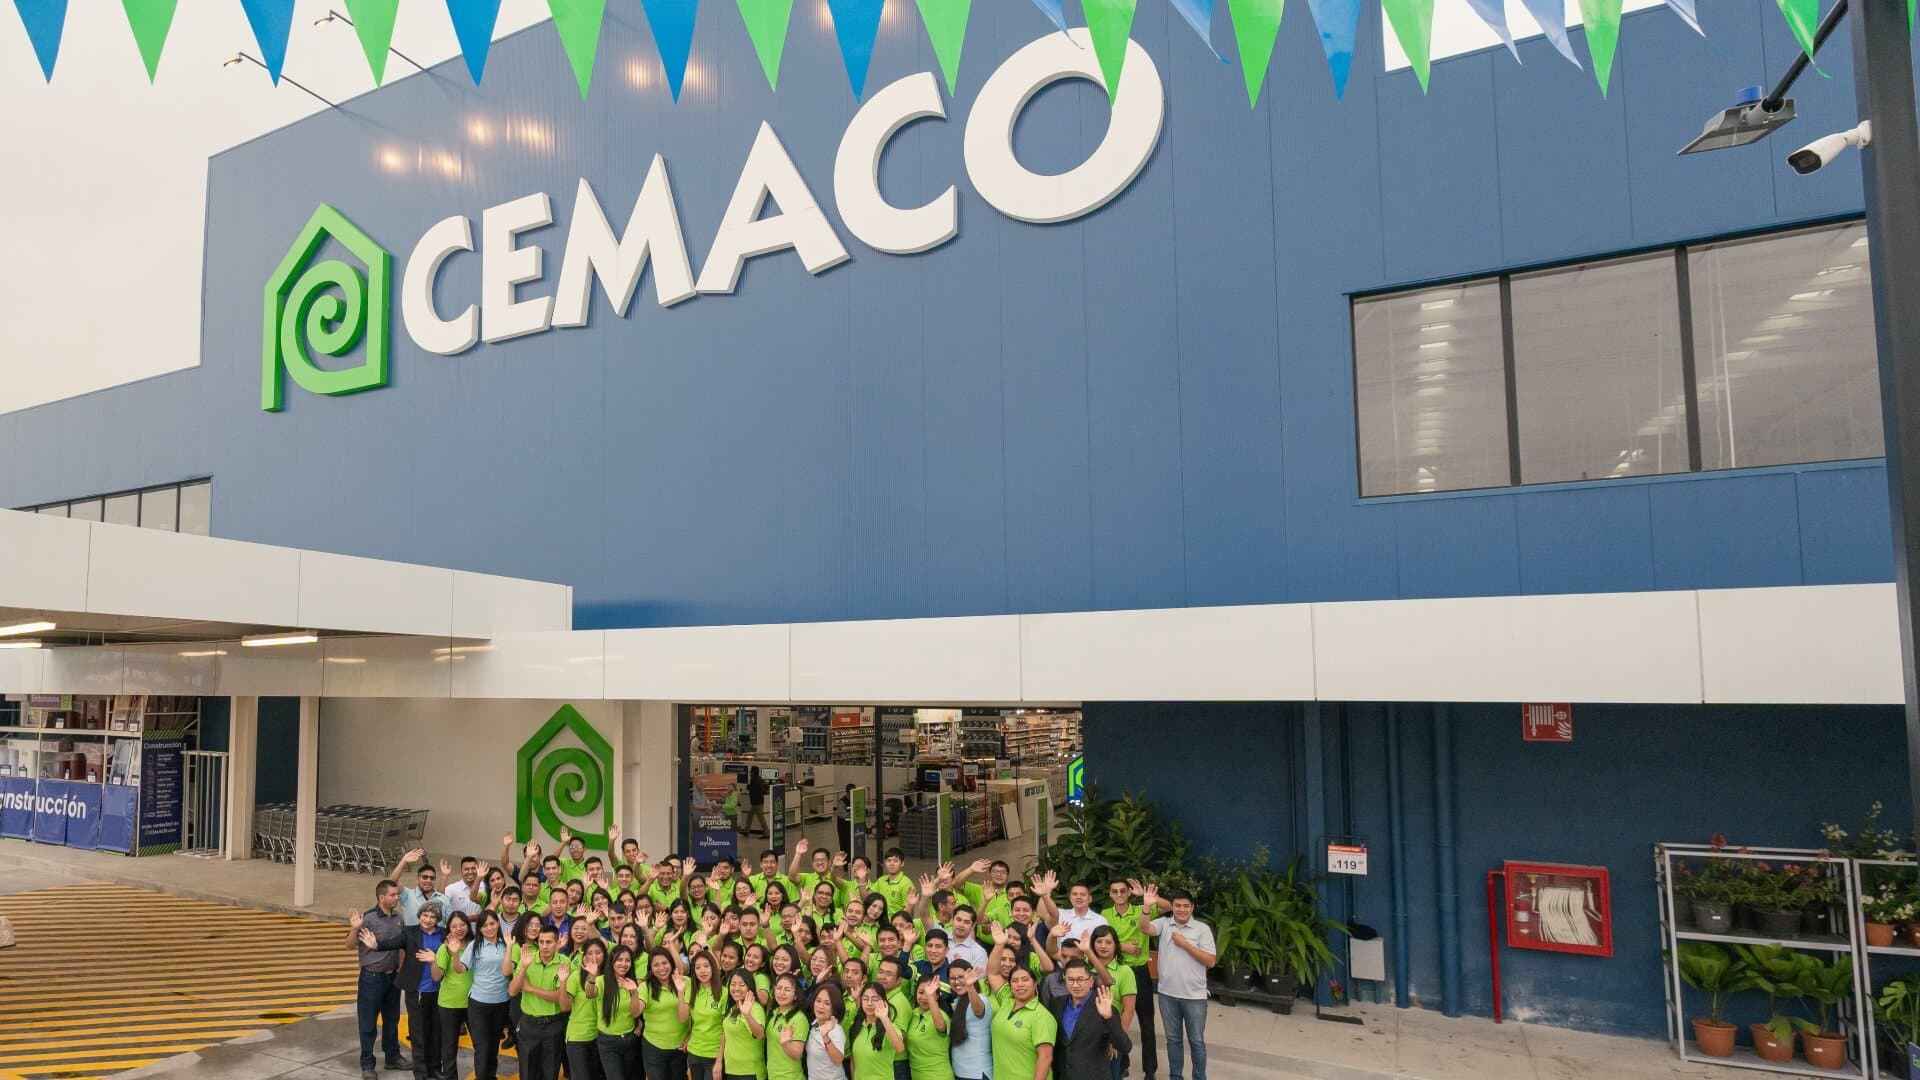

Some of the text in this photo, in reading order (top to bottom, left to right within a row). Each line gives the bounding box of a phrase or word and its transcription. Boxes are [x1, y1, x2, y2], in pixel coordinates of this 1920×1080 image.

[401, 27, 1164, 356] CEMACO
[699, 818, 731, 827] grandes
[1337, 859, 1357, 869] 119
